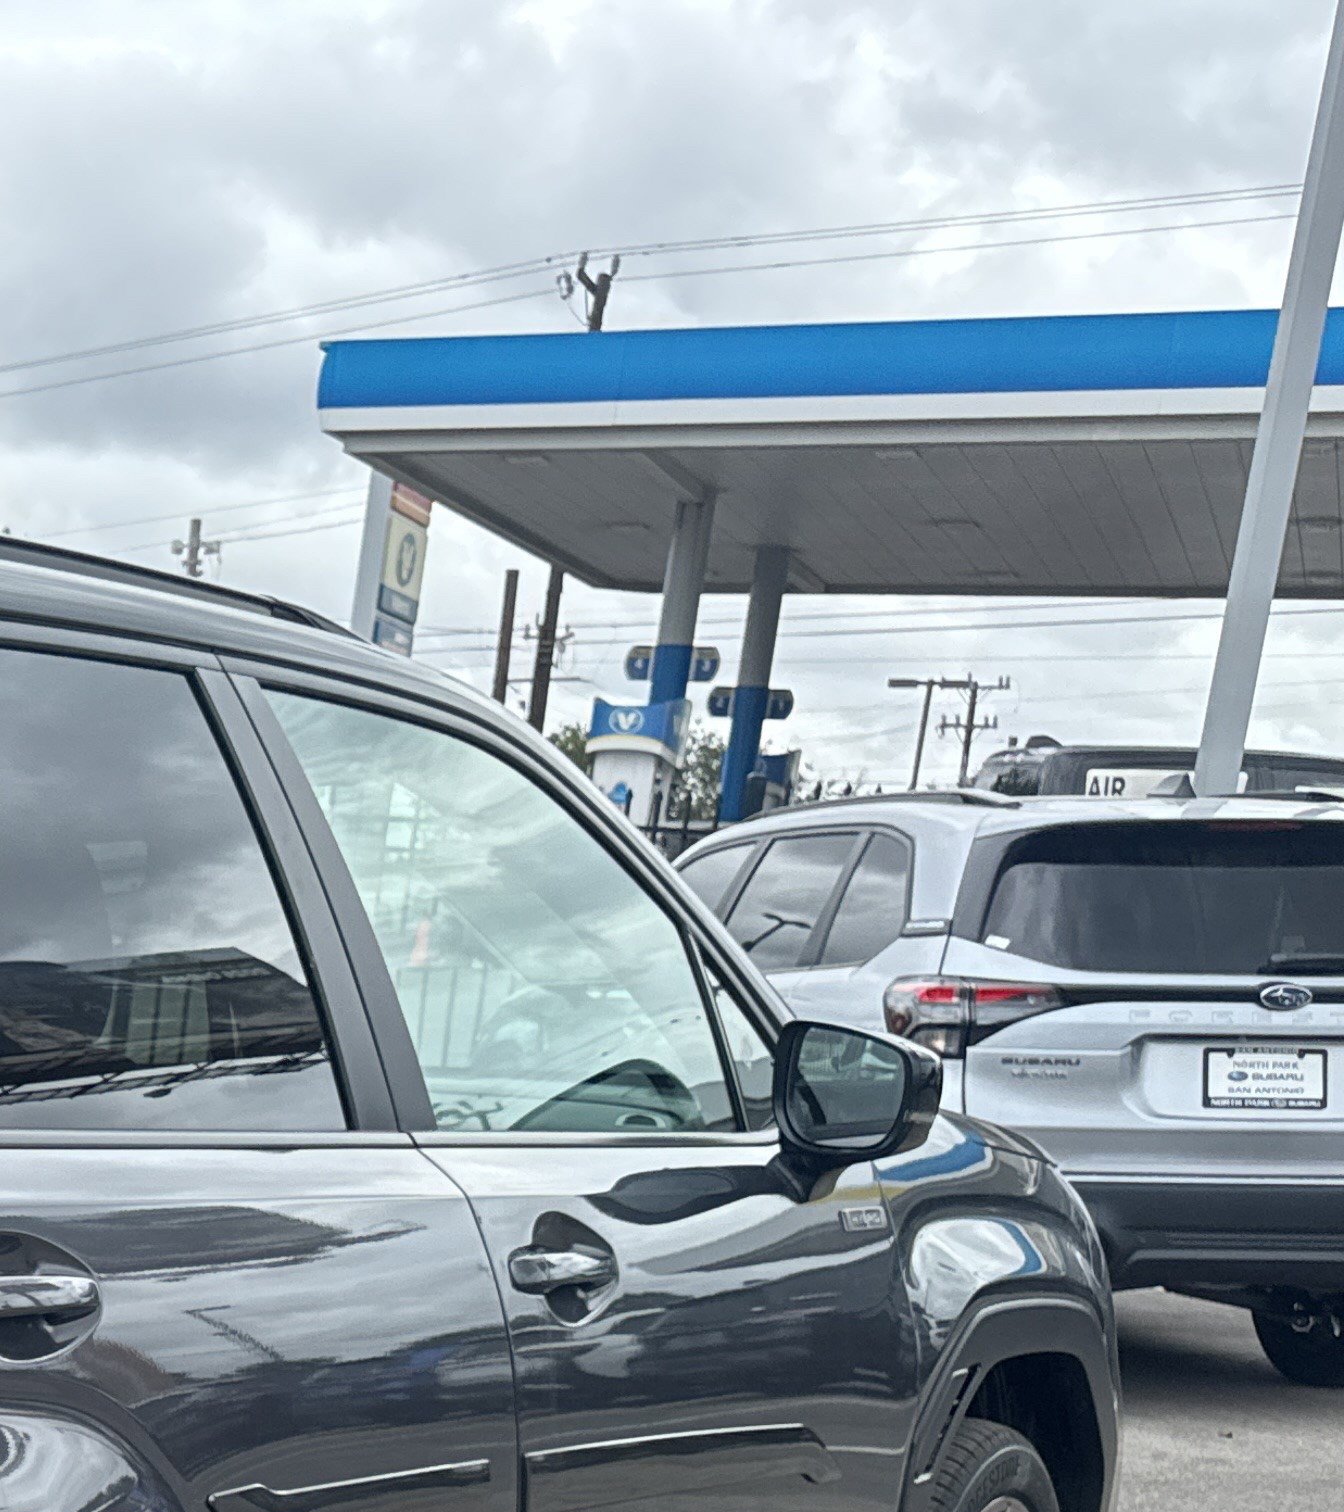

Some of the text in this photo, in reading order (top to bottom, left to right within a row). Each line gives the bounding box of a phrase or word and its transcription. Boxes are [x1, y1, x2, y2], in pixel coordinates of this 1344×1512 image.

[1088, 776, 1125, 796] AIR
[1001, 1056, 1081, 1066] SUBARU
[1232, 1060, 1299, 1070] NORTH PARK
[1251, 1072, 1304, 1082] SUBARU
[1227, 1086, 1305, 1094] SAN ANTONIO
